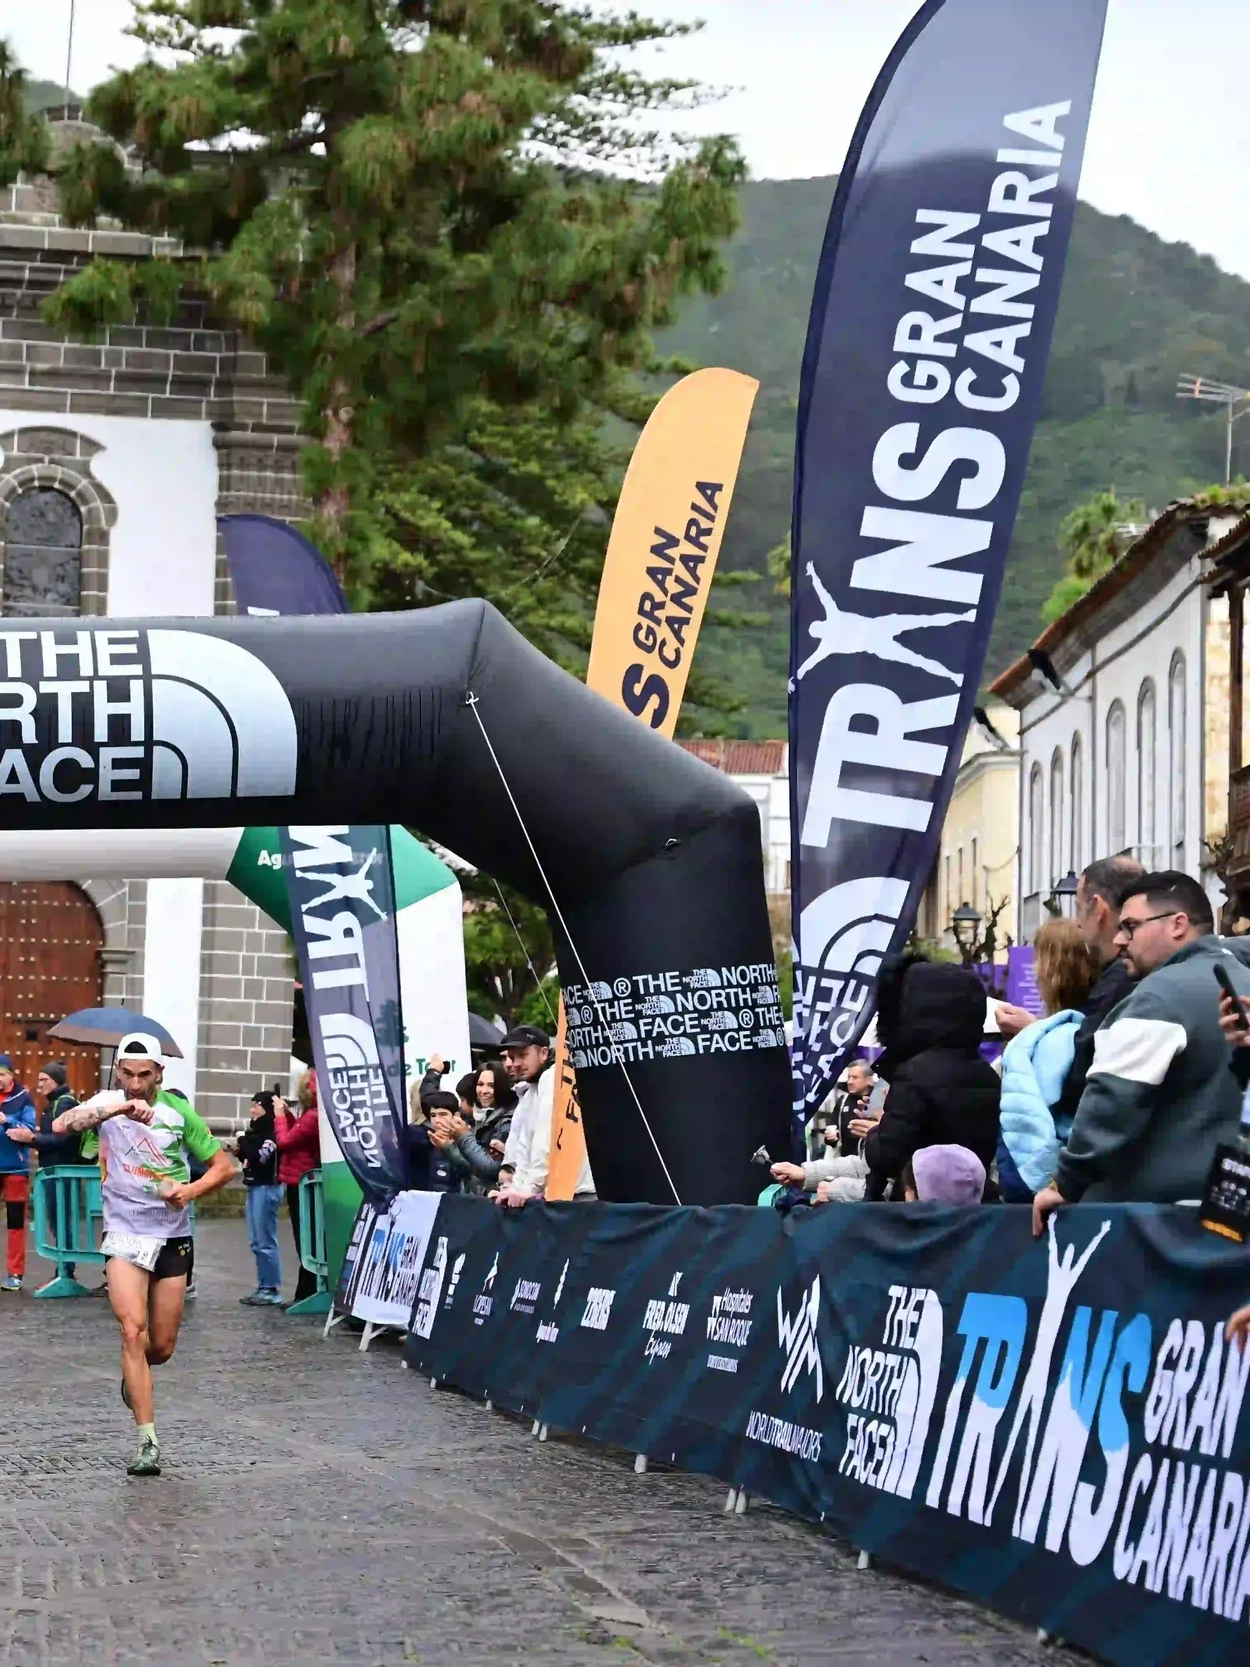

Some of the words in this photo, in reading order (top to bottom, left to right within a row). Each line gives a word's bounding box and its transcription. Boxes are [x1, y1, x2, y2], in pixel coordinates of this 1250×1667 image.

[954, 99, 1072, 413] CANARIA
[887, 208, 981, 404] GRAN
[633, 525, 680, 654] GRAN
[658, 481, 724, 669] CANARIA
[593, 999, 635, 1022] THE
[675, 985, 752, 1012] NORTH
[632, 971, 682, 995] THE
[721, 963, 773, 986] NORTH
[568, 1025, 603, 1048] ORTH
[639, 1013, 701, 1038] FACE
[755, 1006, 780, 1026] THE
[586, 1040, 654, 1067] NORTH
[697, 1031, 753, 1054] FACE
[882, 1285, 927, 1349] THE
[835, 1344, 910, 1417] NORTH
[1144, 1318, 1250, 1459] GRAN
[838, 1413, 893, 1486] FACE
[1112, 1453, 1250, 1624] CANARI
